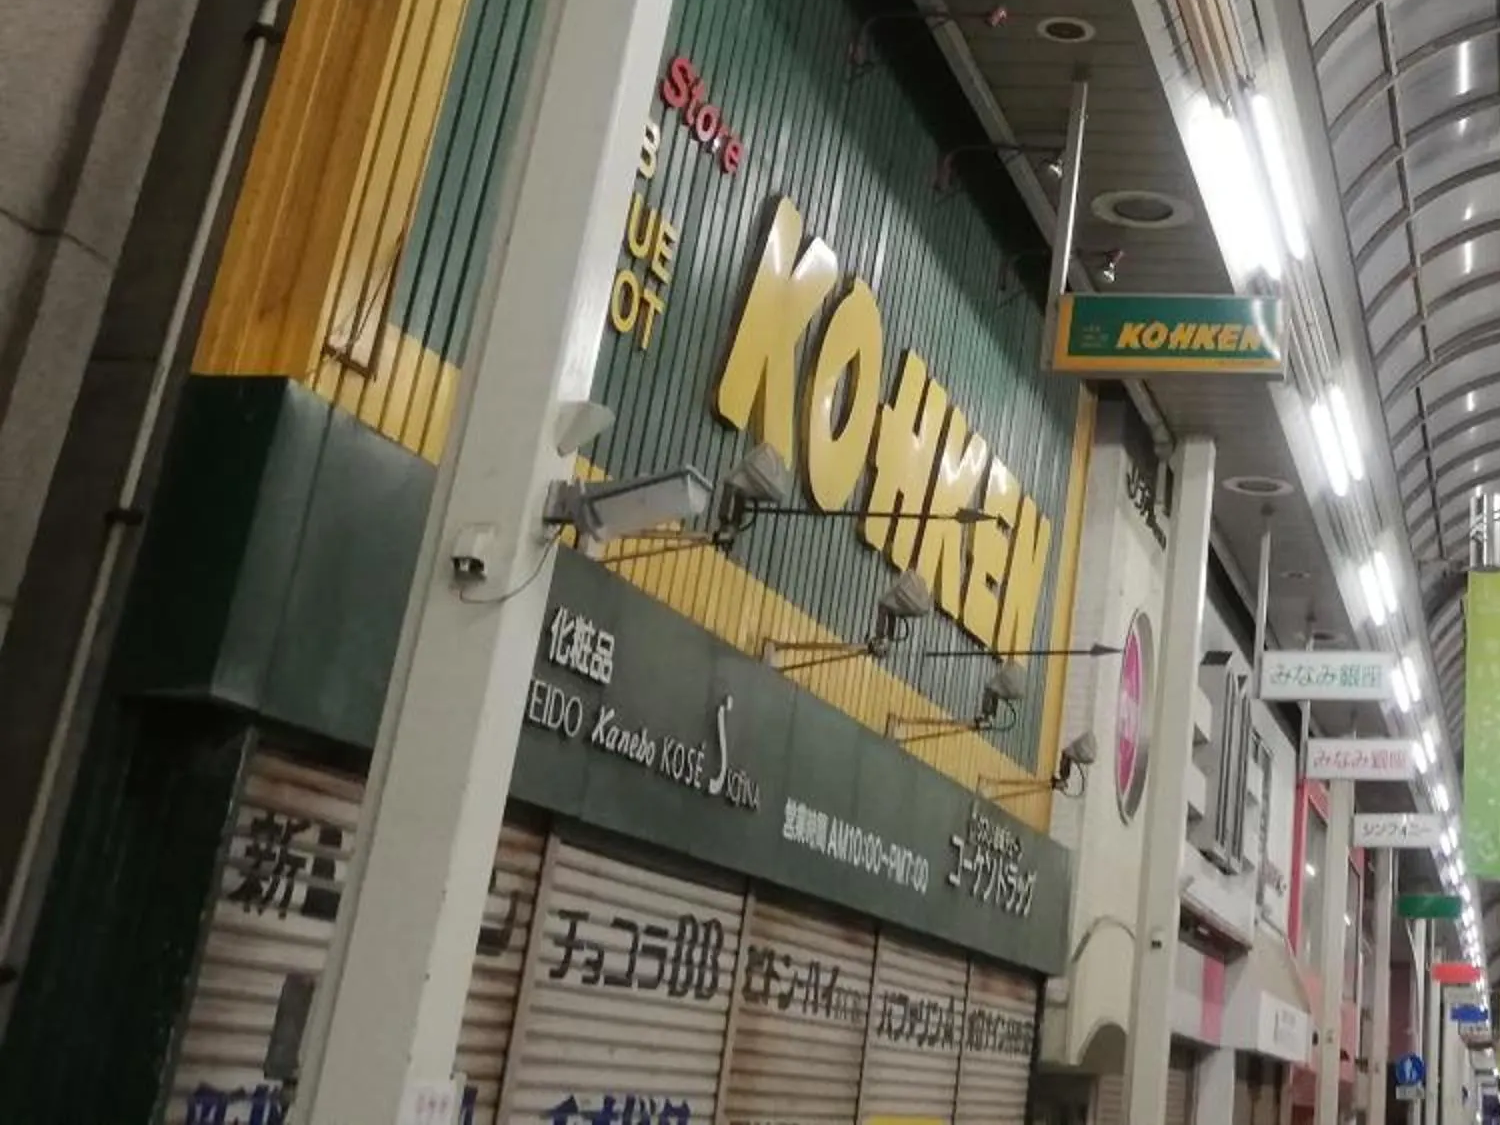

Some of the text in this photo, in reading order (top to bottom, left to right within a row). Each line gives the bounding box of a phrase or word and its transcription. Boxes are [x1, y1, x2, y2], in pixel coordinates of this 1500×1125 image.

[659, 57, 744, 175] Store
[1116, 321, 1262, 351] KOHKEN
[714, 195, 1051, 664] KOHKEN
[549, 606, 615, 685] 化粧品
[1269, 663, 1382, 689] みなみ銀座
[591, 704, 656, 767] Kanebo
[548, 908, 724, 999] チョコラBB
